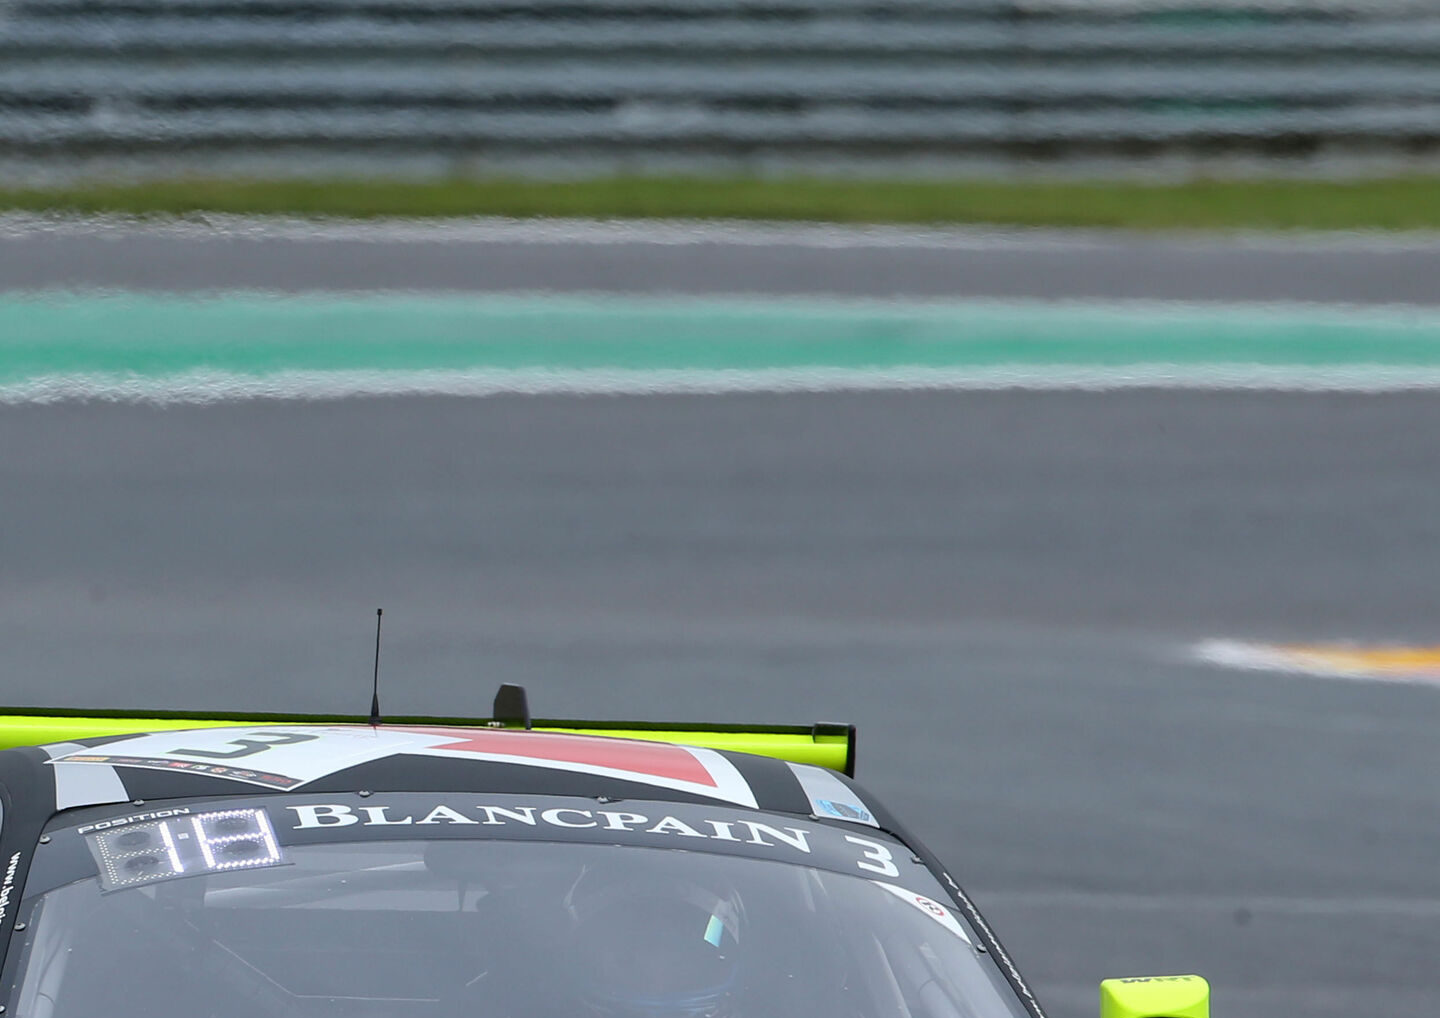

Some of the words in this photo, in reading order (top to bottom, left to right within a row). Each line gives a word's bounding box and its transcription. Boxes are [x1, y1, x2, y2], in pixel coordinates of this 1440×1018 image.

[166, 732, 320, 759] 3
[78, 807, 190, 835] POSITION
[285, 804, 811, 853] BLANCPAIN
[845, 835, 899, 878] 3
